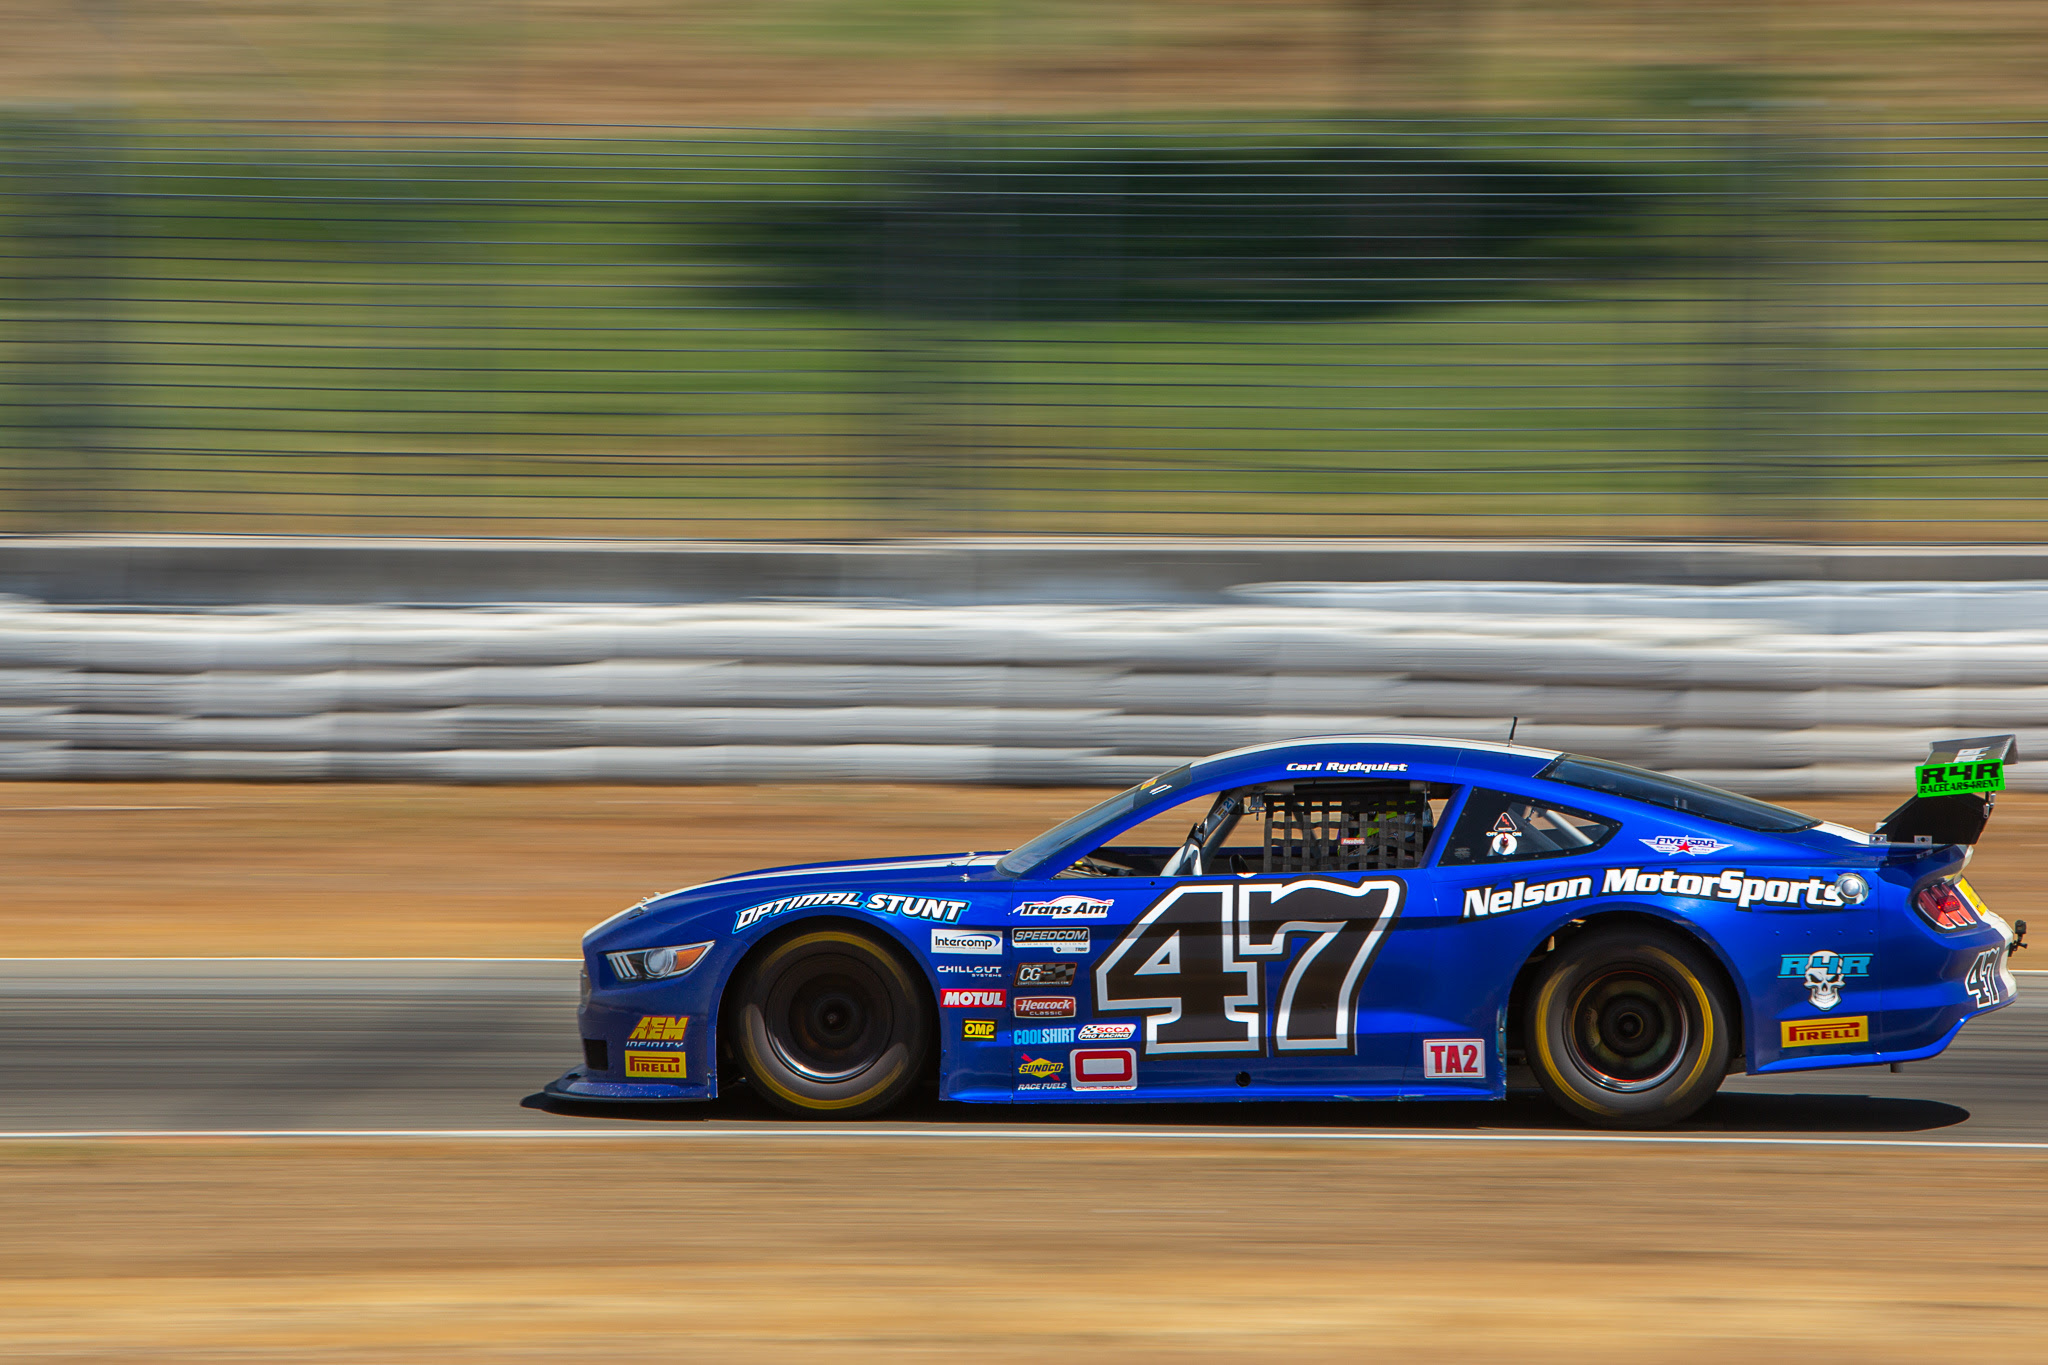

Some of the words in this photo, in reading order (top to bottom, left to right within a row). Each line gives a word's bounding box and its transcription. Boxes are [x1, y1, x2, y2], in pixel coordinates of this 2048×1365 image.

[1286, 762, 1322, 771] Carl
[1326, 762, 1408, 773] Rydquist
[1921, 762, 2000, 784] R4R
[1688, 839, 1715, 848] STAR
[1463, 876, 1592, 918] Nelson
[1601, 869, 1844, 907] MotorSports
[736, 893, 860, 931] OPTIMAL
[866, 894, 967, 921] STUNT
[1022, 903, 1072, 914] Trans
[1073, 902, 1108, 914] Am
[935, 936, 992, 950] Intercomp
[1014, 930, 1087, 941] SPEEDCOM
[937, 965, 1002, 973] CHILLOUT
[1092, 876, 1406, 1059] 47
[1780, 955, 1870, 975] R4R
[1020, 968, 1042, 981] CG
[1965, 947, 2000, 1008] 47
[943, 991, 1003, 1006] MOTUL
[1018, 999, 1072, 1011] Heacock
[628, 1016, 690, 1040] AEM
[964, 1023, 995, 1035] OMP
[1788, 1022, 1860, 1042] PIRELLI
[1013, 1028, 1076, 1045] COOLSHIRT
[629, 1056, 680, 1073] PIRELLI
[1430, 1045, 1478, 1073] TA2
[1021, 1063, 1062, 1073] SUNOCO
[1018, 1083, 1041, 1091] RACE
[1041, 1082, 1067, 1090] FUELS
